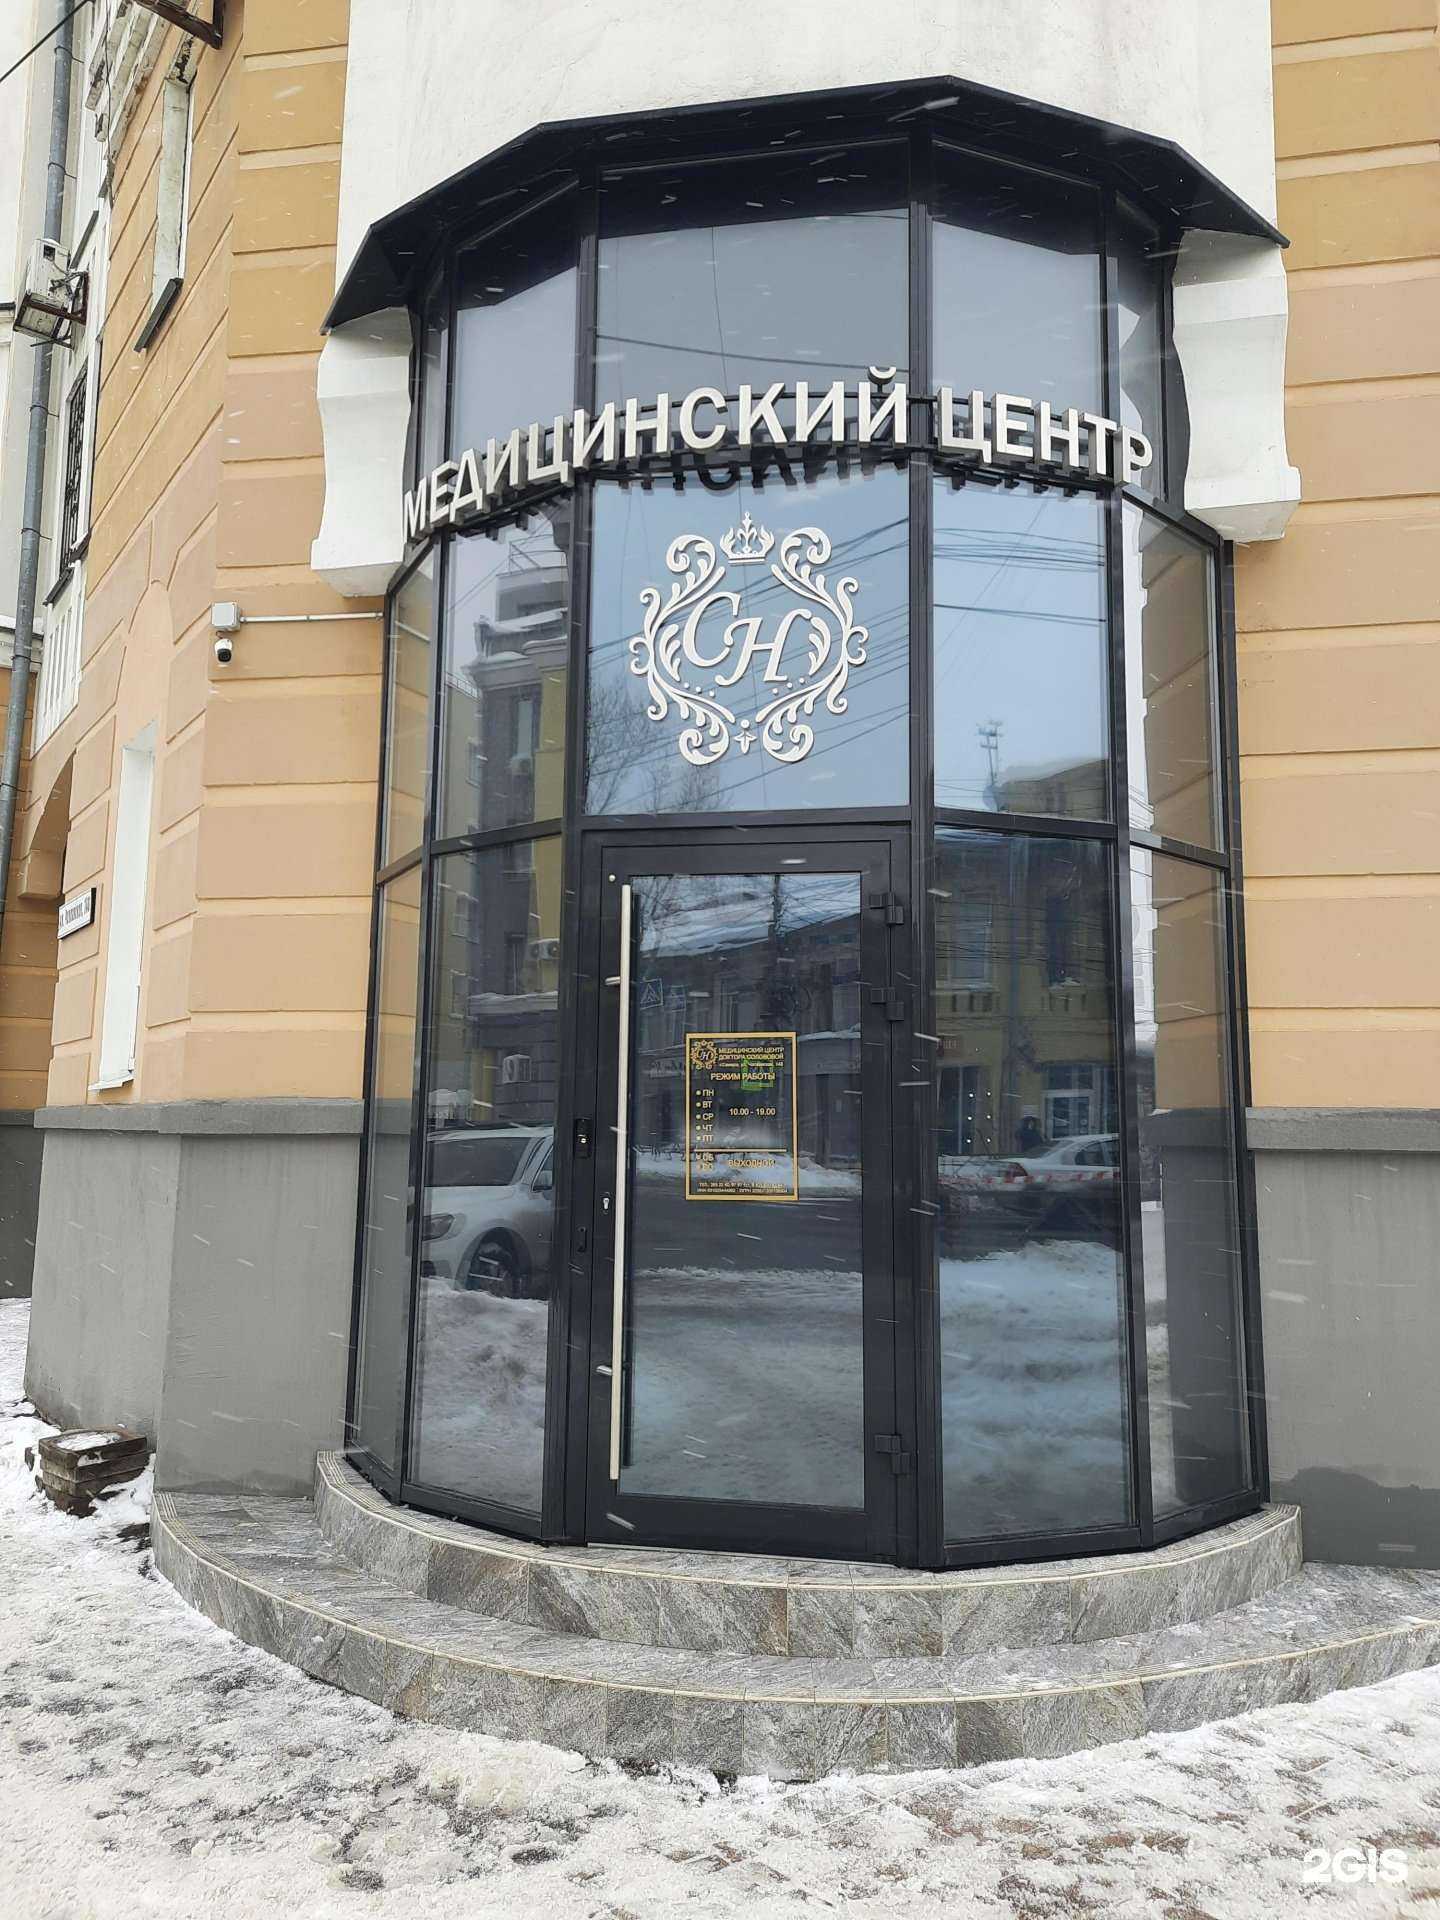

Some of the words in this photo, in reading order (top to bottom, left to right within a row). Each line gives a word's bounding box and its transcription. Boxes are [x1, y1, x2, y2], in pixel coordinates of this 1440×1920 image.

[402, 366, 909, 542] МЕДИЦИНСКИЙ
[934, 386, 1155, 486] ЦЕНТР
[710, 1073, 741, 1081] РЕЖИМ
[742, 1072, 776, 1080] РАБОТЫ
[702, 1089, 714, 1097] ПН
[729, 1108, 749, 1116] 10.00
[756, 1108, 776, 1116] 19.00
[702, 1113, 714, 1121] СР
[728, 1159, 776, 1168] ВЫХОДНОЙ
